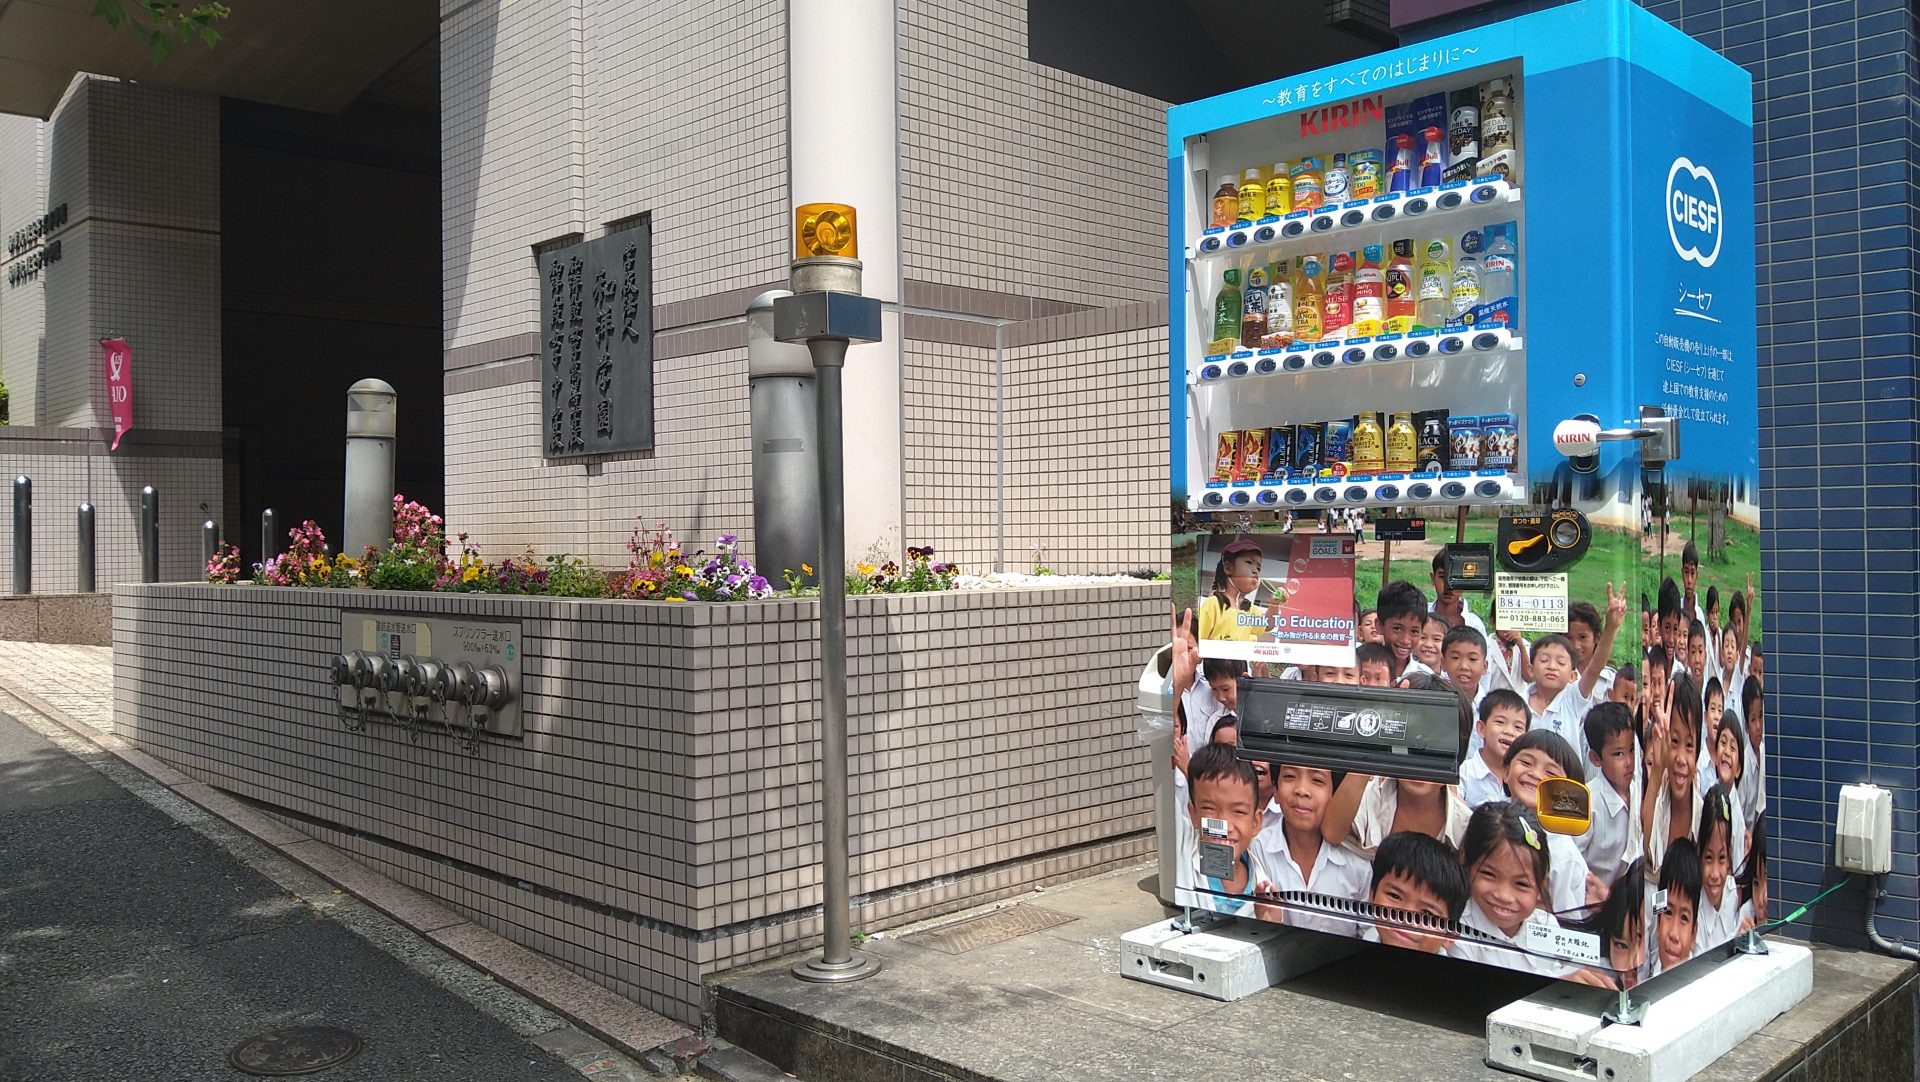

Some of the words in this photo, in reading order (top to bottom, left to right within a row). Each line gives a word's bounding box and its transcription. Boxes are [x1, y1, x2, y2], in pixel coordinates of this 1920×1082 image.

[1300, 95, 1384, 137] KIRIN
[1672, 189, 1717, 234] CIESF
[621, 241, 640, 344] 学校法人
[1677, 281, 1713, 311] シーセフ
[1218, 300, 1231, 324] 生茶
[1557, 432, 1591, 444] KIRIN
[1312, 547, 1337, 555] GOALS
[1237, 613, 1269, 627] Drink
[1273, 615, 1287, 627] To
[1290, 615, 1354, 630] Education
[452, 626, 512, 642] スプリンクラー送水口
